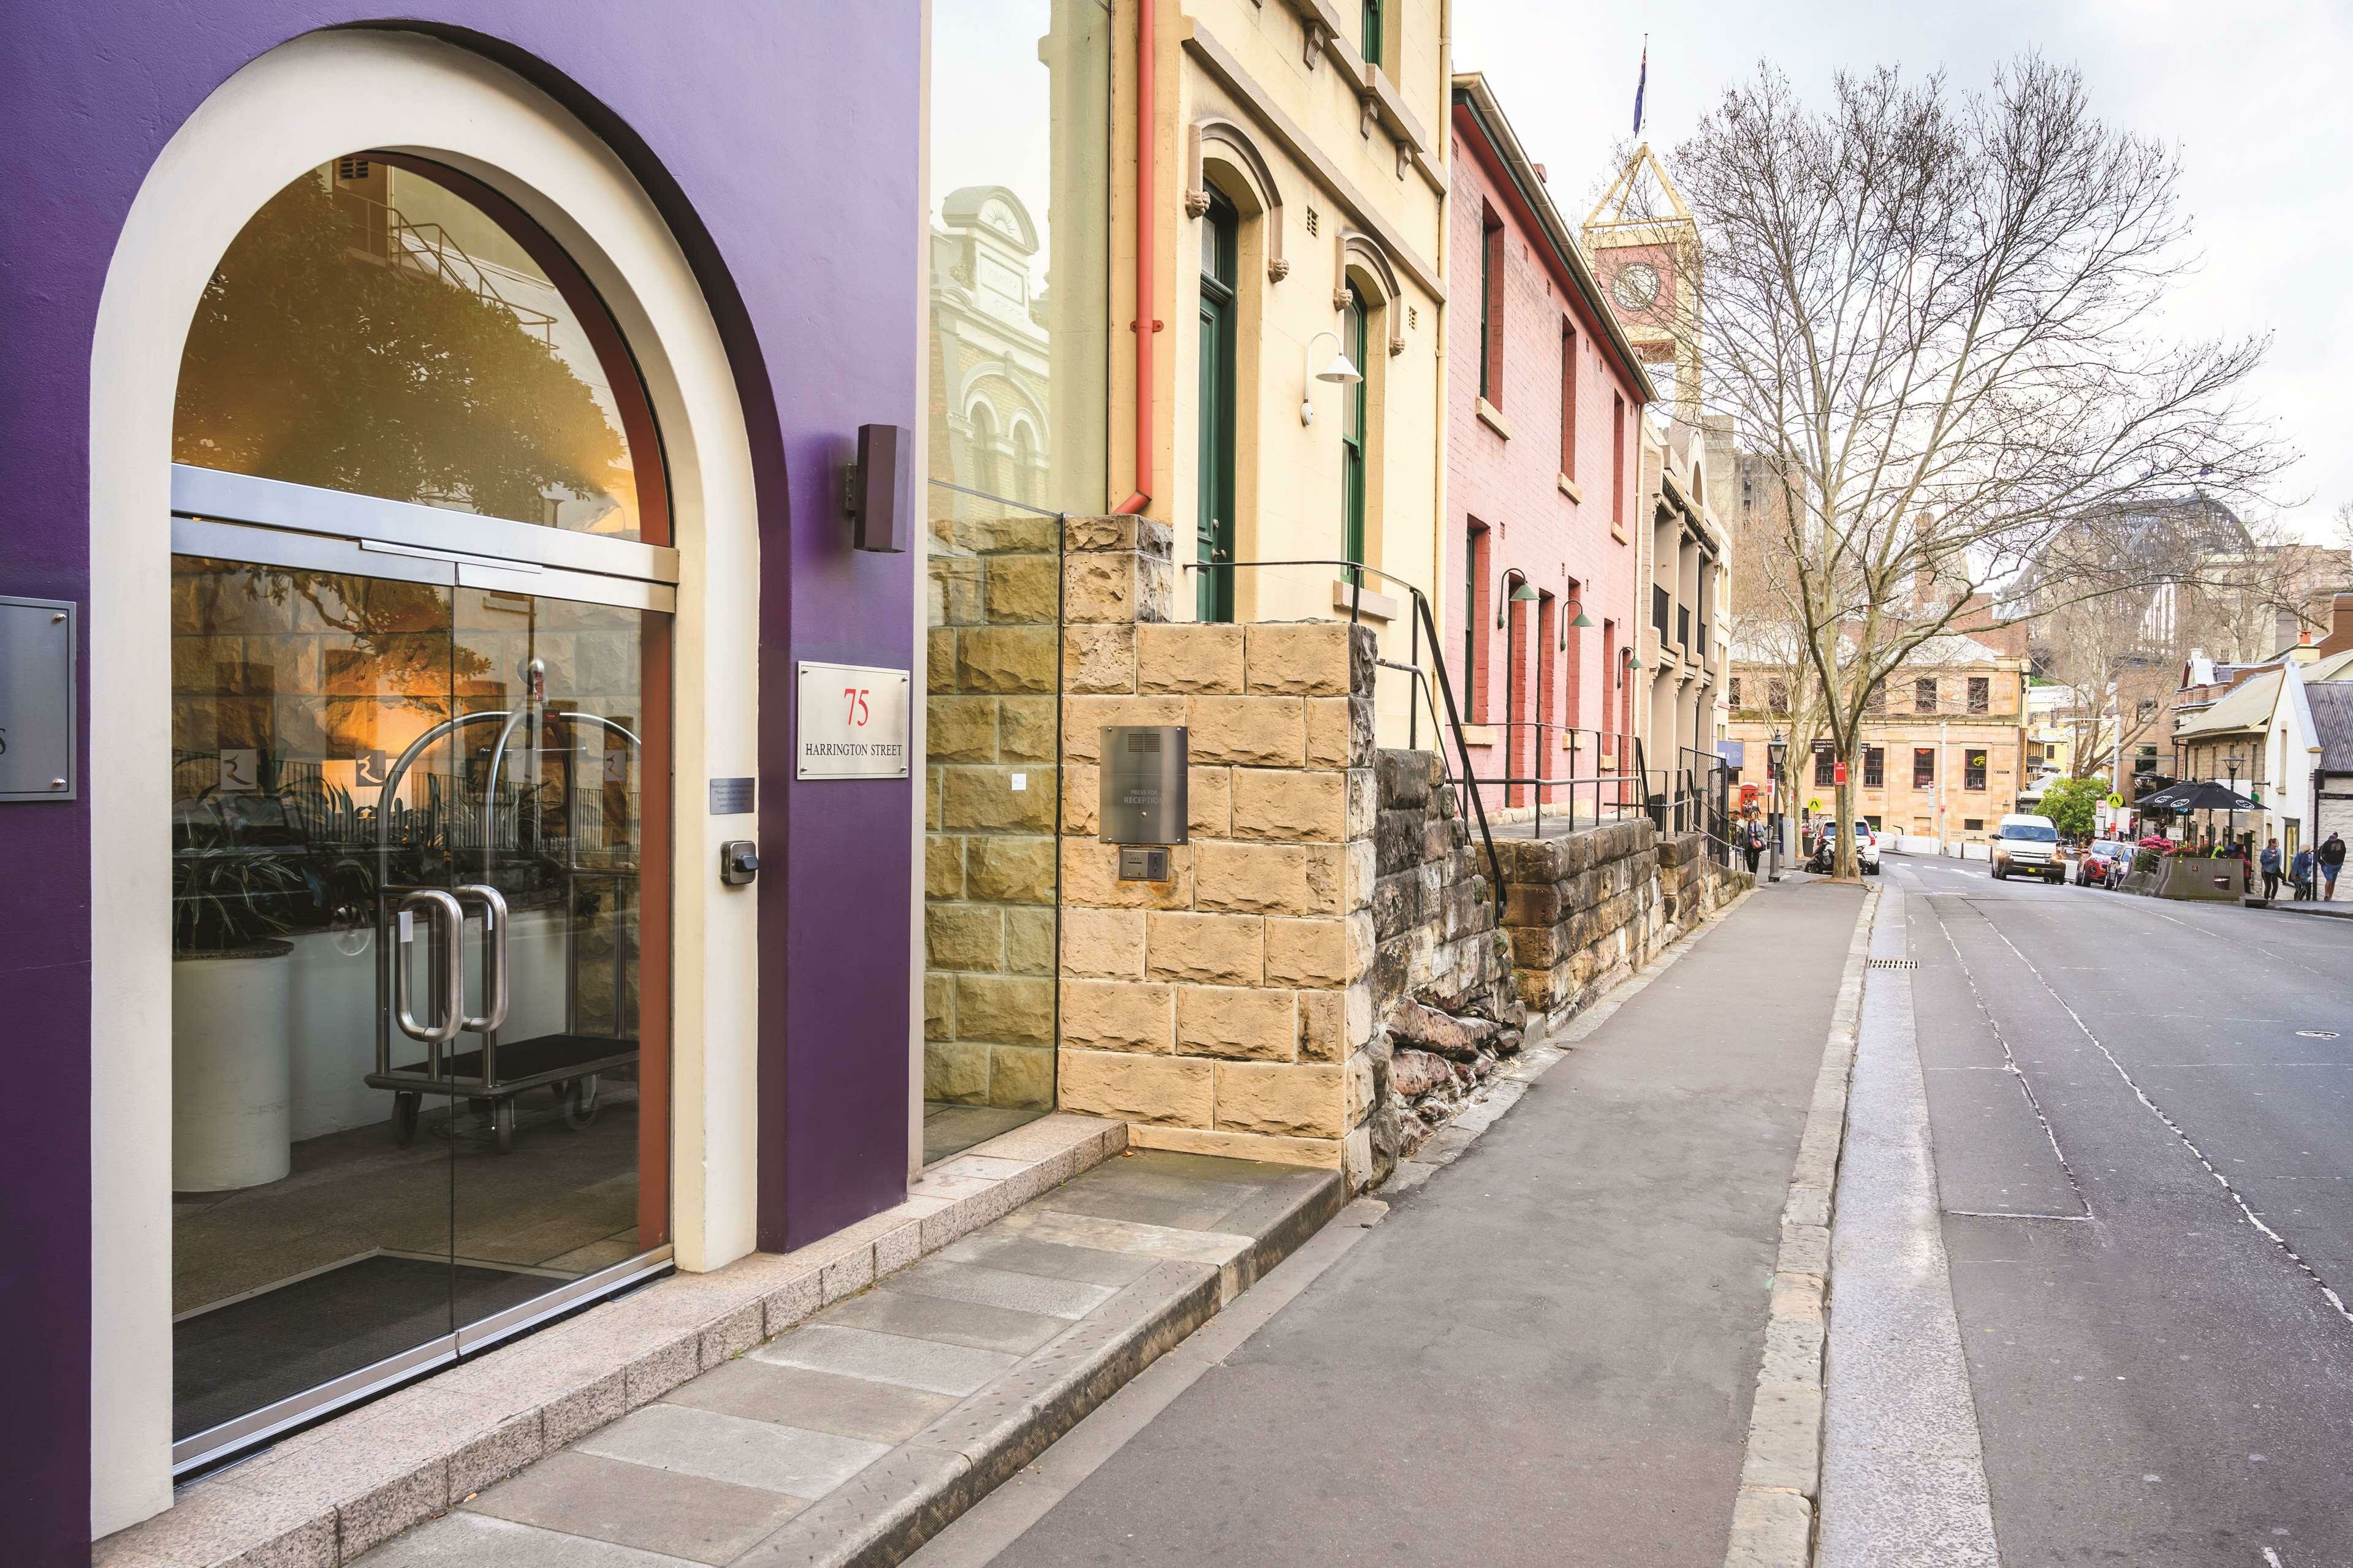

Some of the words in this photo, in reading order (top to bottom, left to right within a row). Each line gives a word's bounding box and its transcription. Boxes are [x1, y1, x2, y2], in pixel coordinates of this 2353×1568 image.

[843, 688, 869, 726] 75
[805, 743, 868, 756] HARRINGTON
[871, 744, 902, 756] STREET
